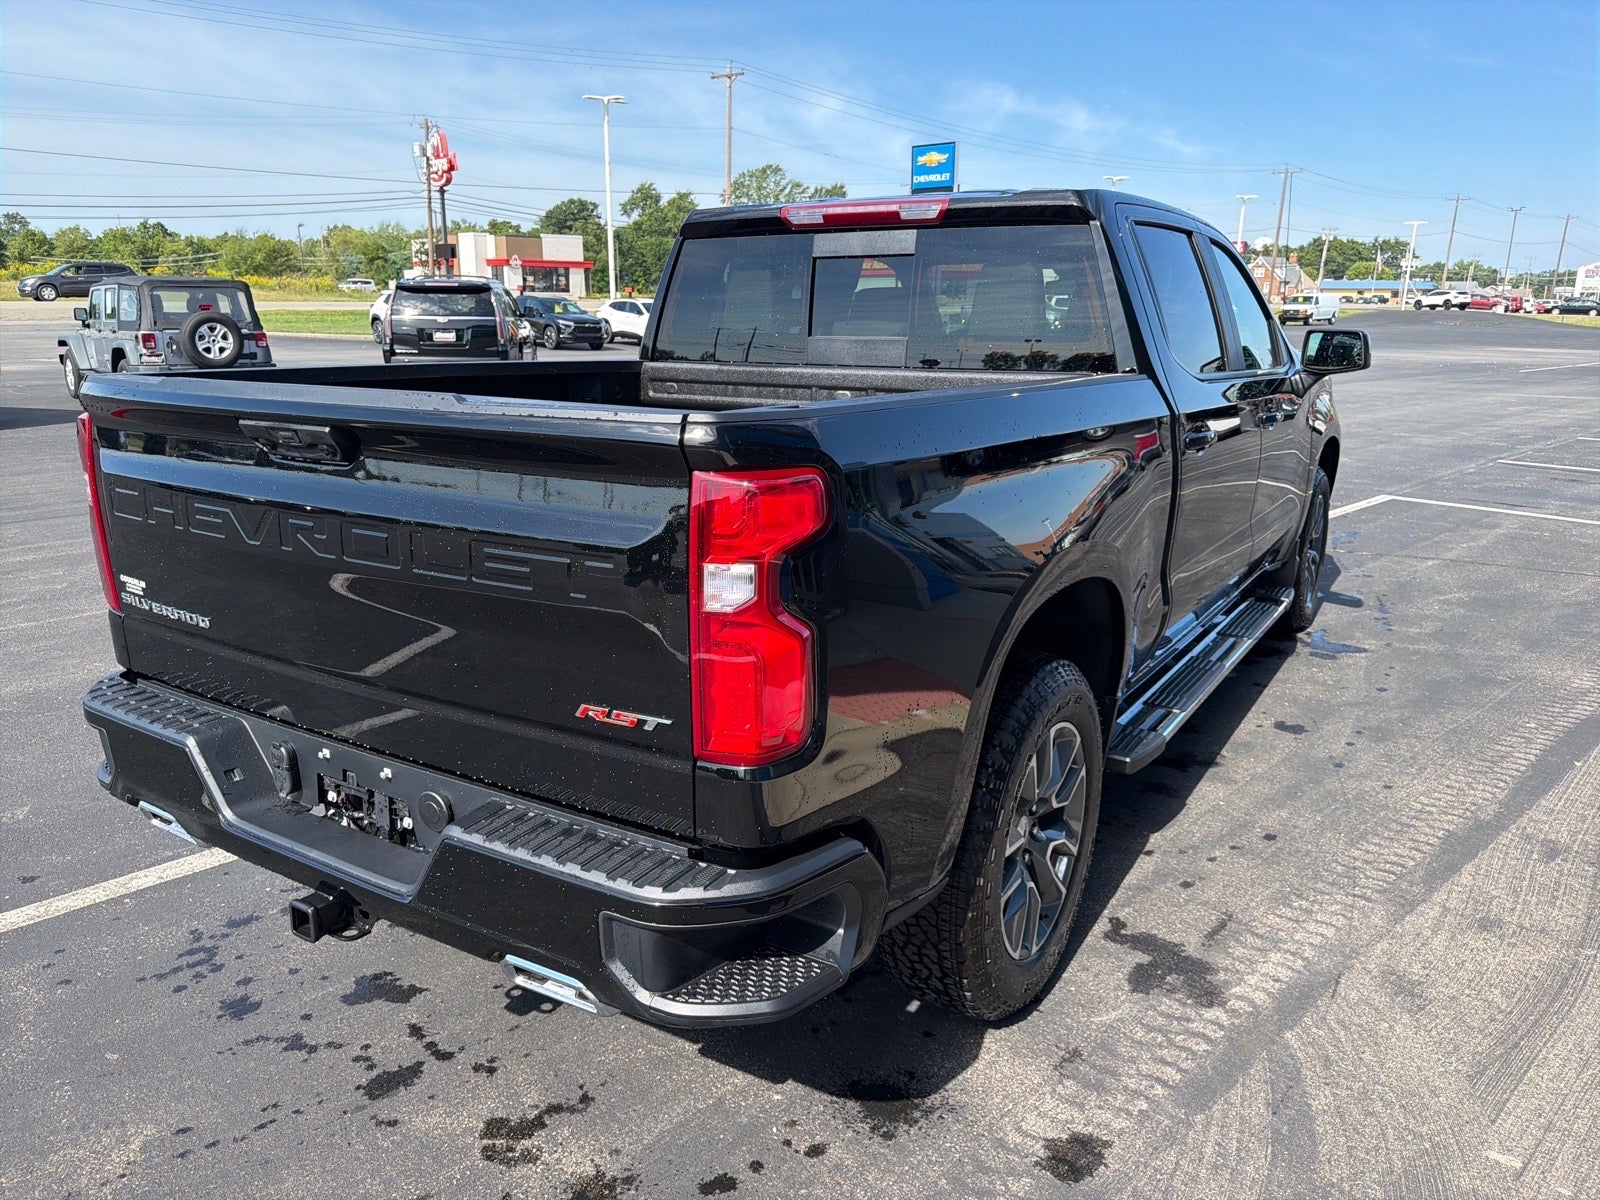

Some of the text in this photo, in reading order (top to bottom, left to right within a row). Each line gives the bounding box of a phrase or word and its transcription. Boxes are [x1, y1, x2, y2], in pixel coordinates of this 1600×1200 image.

[913, 173, 951, 183] CHEVROLET
[110, 480, 616, 598] CHEVROLET
[120, 591, 212, 629] SILVERADO
[575, 703, 674, 731] RST
